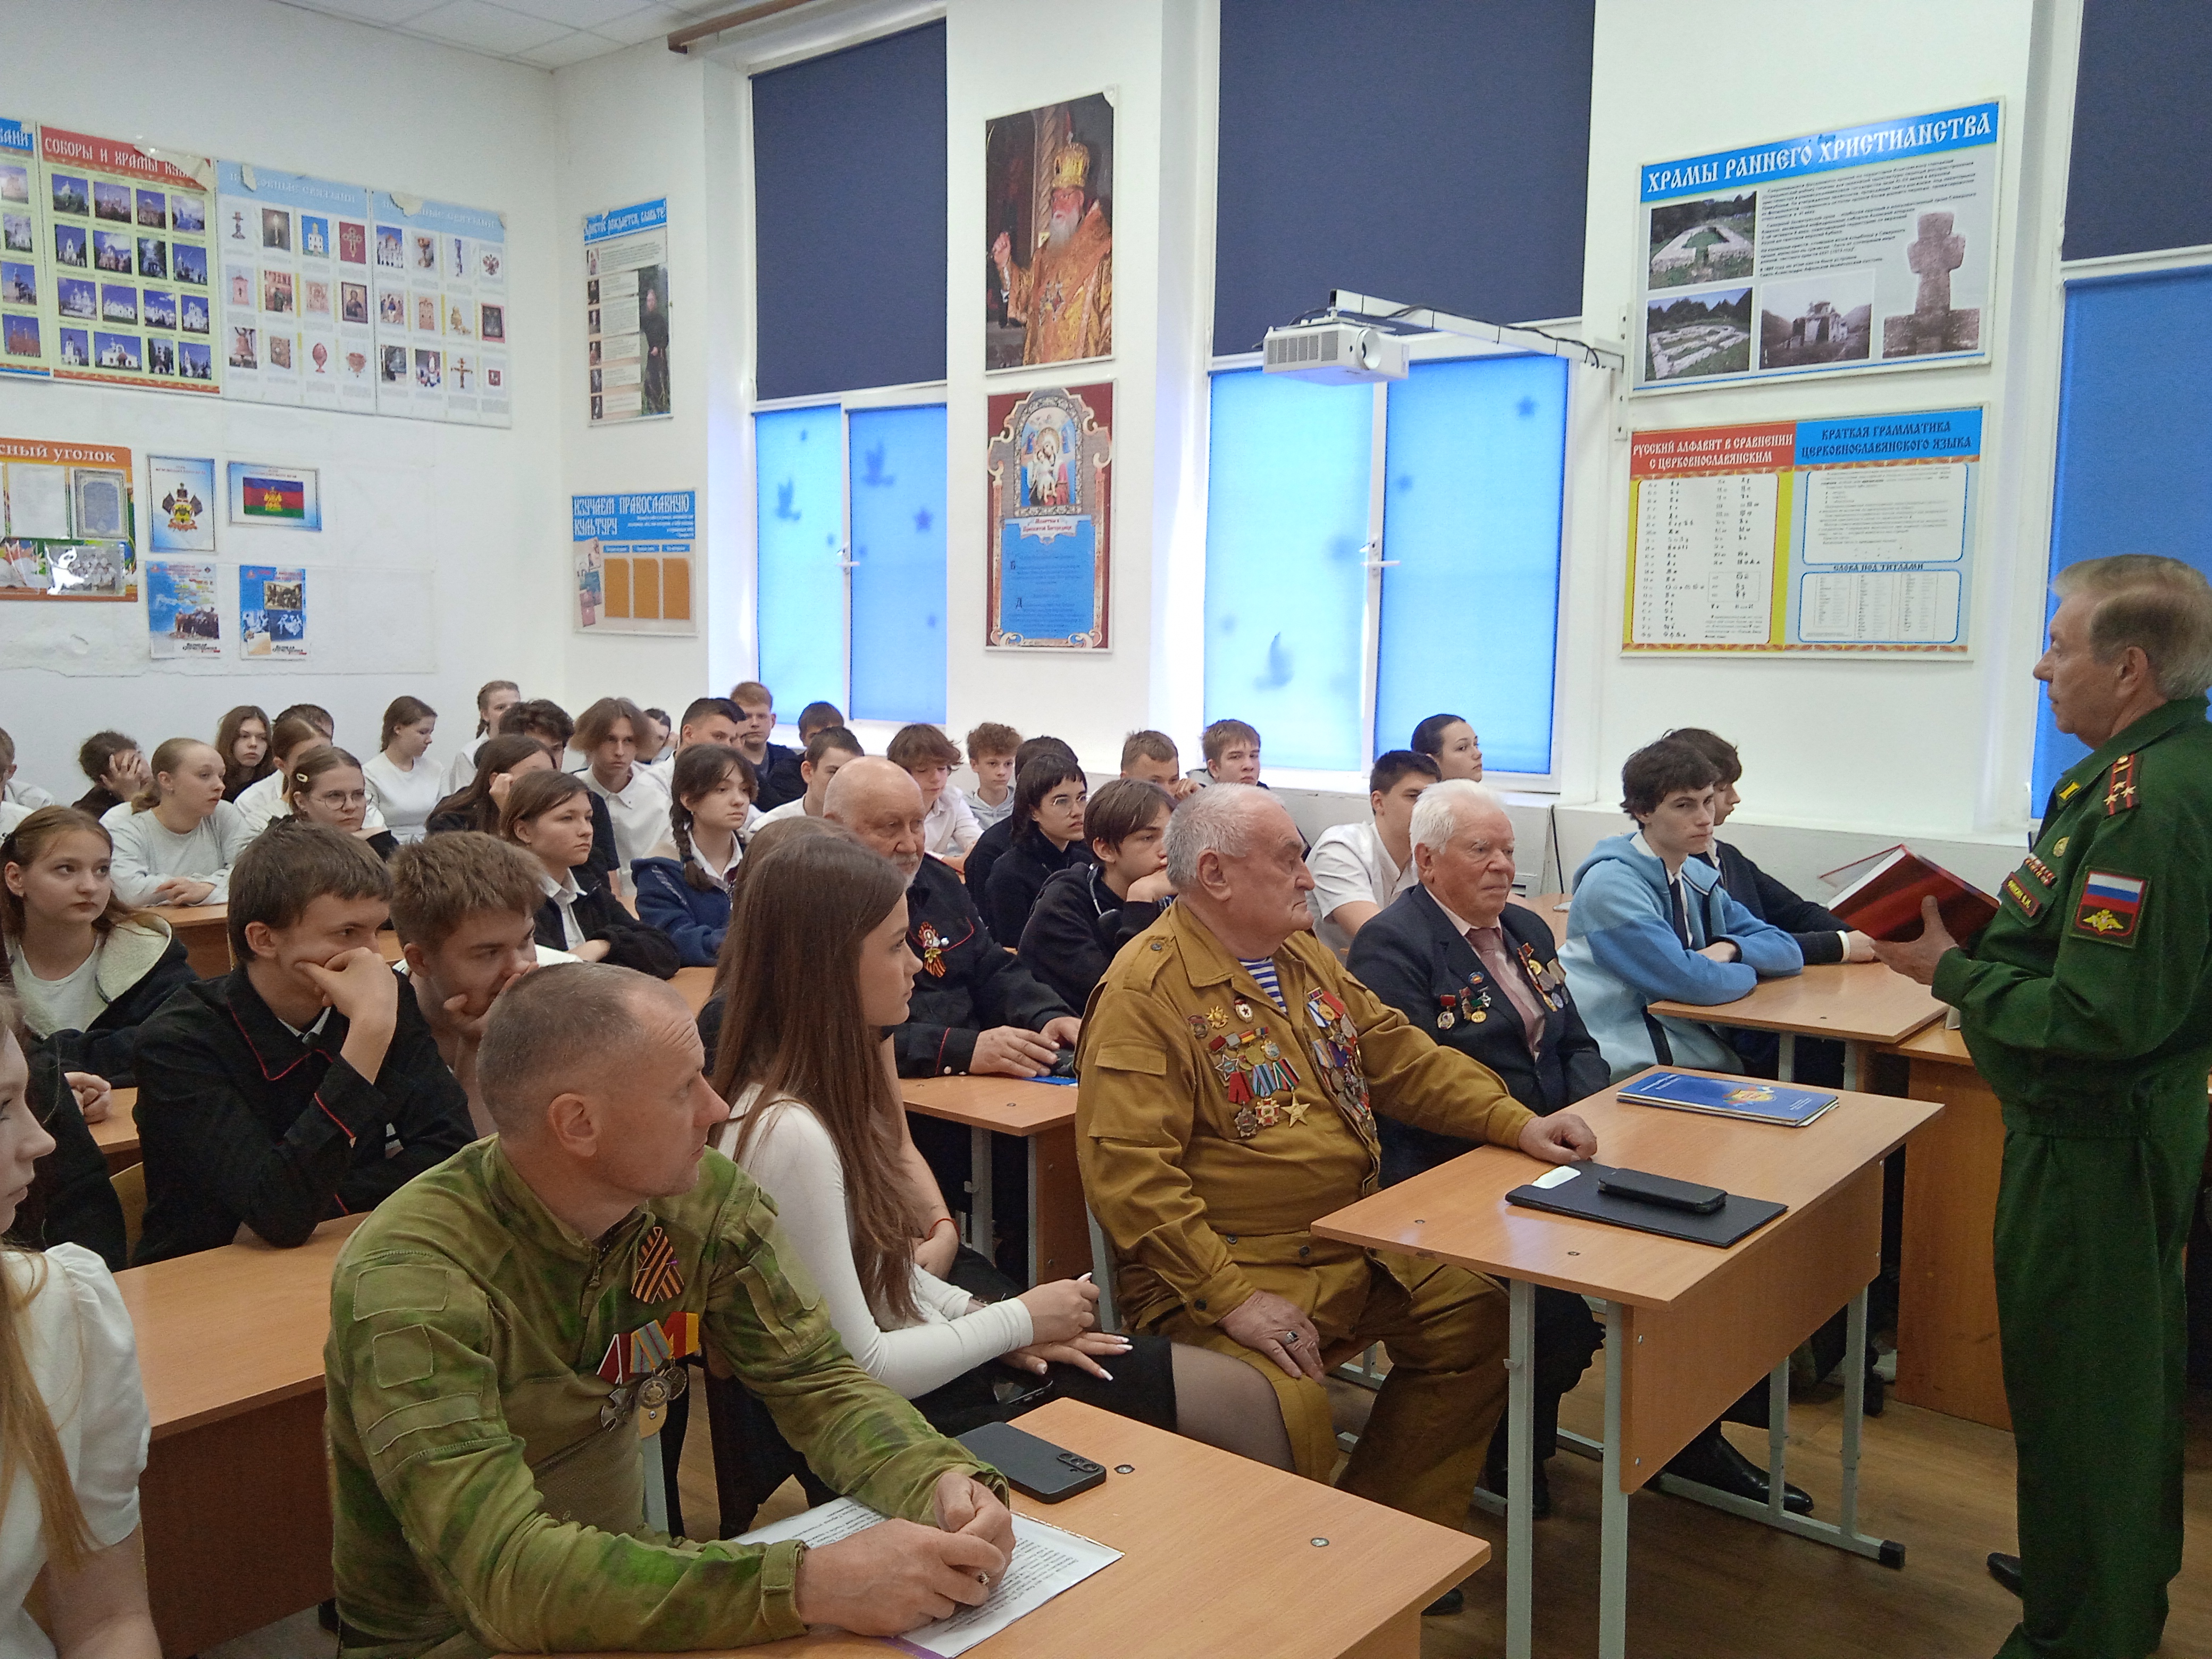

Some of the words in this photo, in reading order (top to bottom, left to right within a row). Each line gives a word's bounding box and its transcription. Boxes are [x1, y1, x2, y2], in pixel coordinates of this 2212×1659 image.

[45, 137, 93, 160] СОБОРЫ
[100, 147, 108, 163] И
[114, 150, 158, 172] ХРАМЫ
[1647, 162, 1719, 193] ХРАМЫ
[1724, 145, 1813, 180] РАННЕГО
[1819, 112, 1992, 163] ХРИСТИАНСТВА
[1822, 426, 1870, 440] КРАТКАЯ
[1873, 421, 1951, 437] ГРАММАТИКА
[54, 447, 116, 463] уголок
[1633, 440, 1674, 458] РУССКИЙ
[1677, 439, 1723, 453] АЛФАВИТ
[1725, 438, 1731, 450] В
[1733, 433, 1794, 449] СРАВНЕНИИ
[1801, 438, 1930, 459] ЦЕРКОВНОСЛАВЯНСКОГО
[1933, 436, 1972, 450] ЯЗЫКА
[1649, 458, 1656, 470] С
[1658, 451, 1772, 471] ЦЕРКОВНОСЛАВЯНСКИМ
[574, 497, 615, 516] ИЗУЧАЕМ
[619, 493, 690, 515] ПРАВОСЛАВНУЮ
[574, 517, 618, 535] КУЛЬТУРУ
